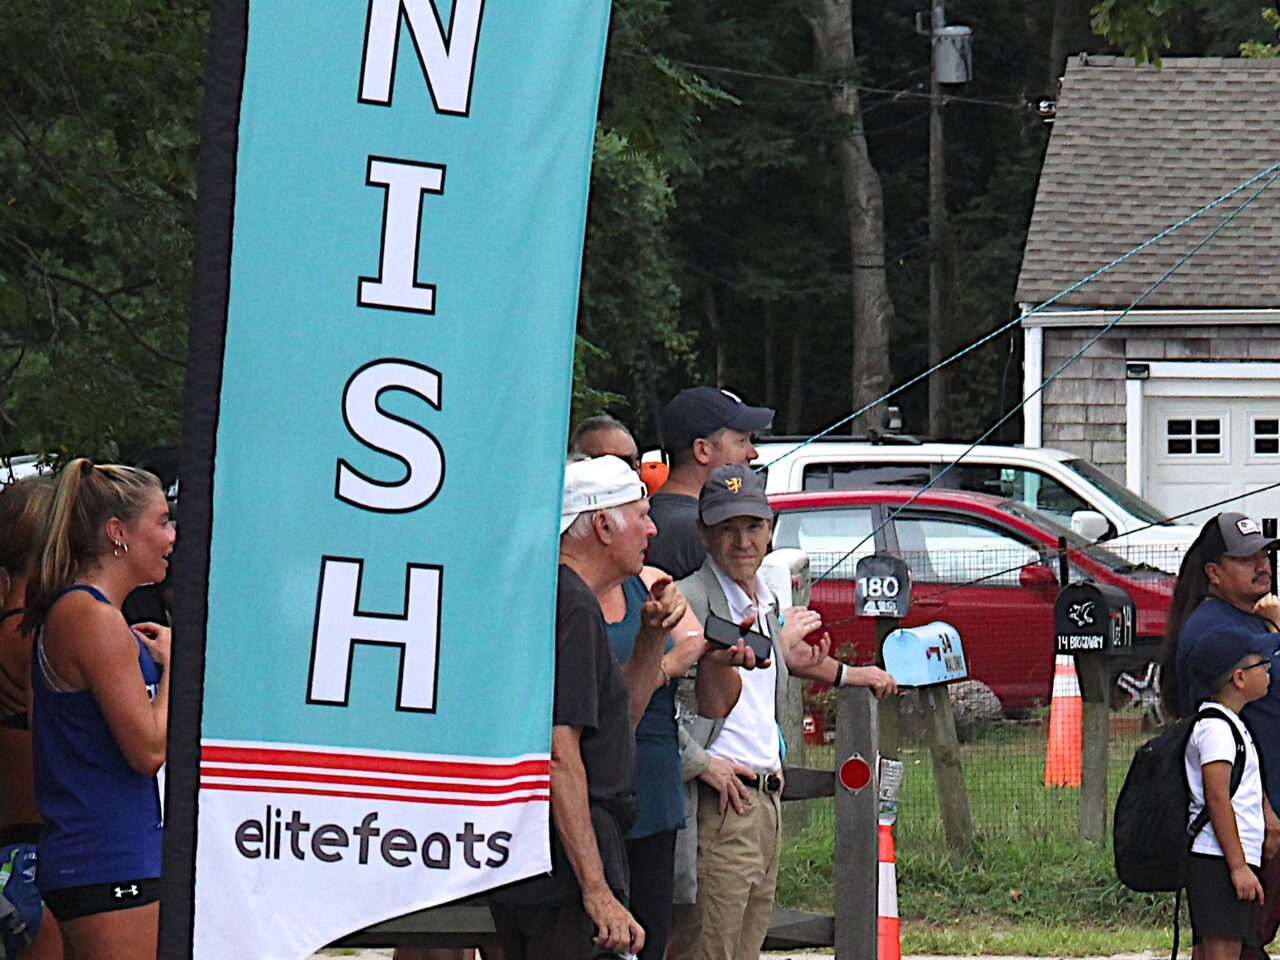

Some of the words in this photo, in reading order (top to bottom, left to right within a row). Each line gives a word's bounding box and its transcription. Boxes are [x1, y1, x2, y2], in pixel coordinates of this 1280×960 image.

[858, 576, 899, 598] 180
[938, 632, 953, 654] 34
[1057, 635, 1068, 650] 14
[234, 804, 513, 870] elitefeats
